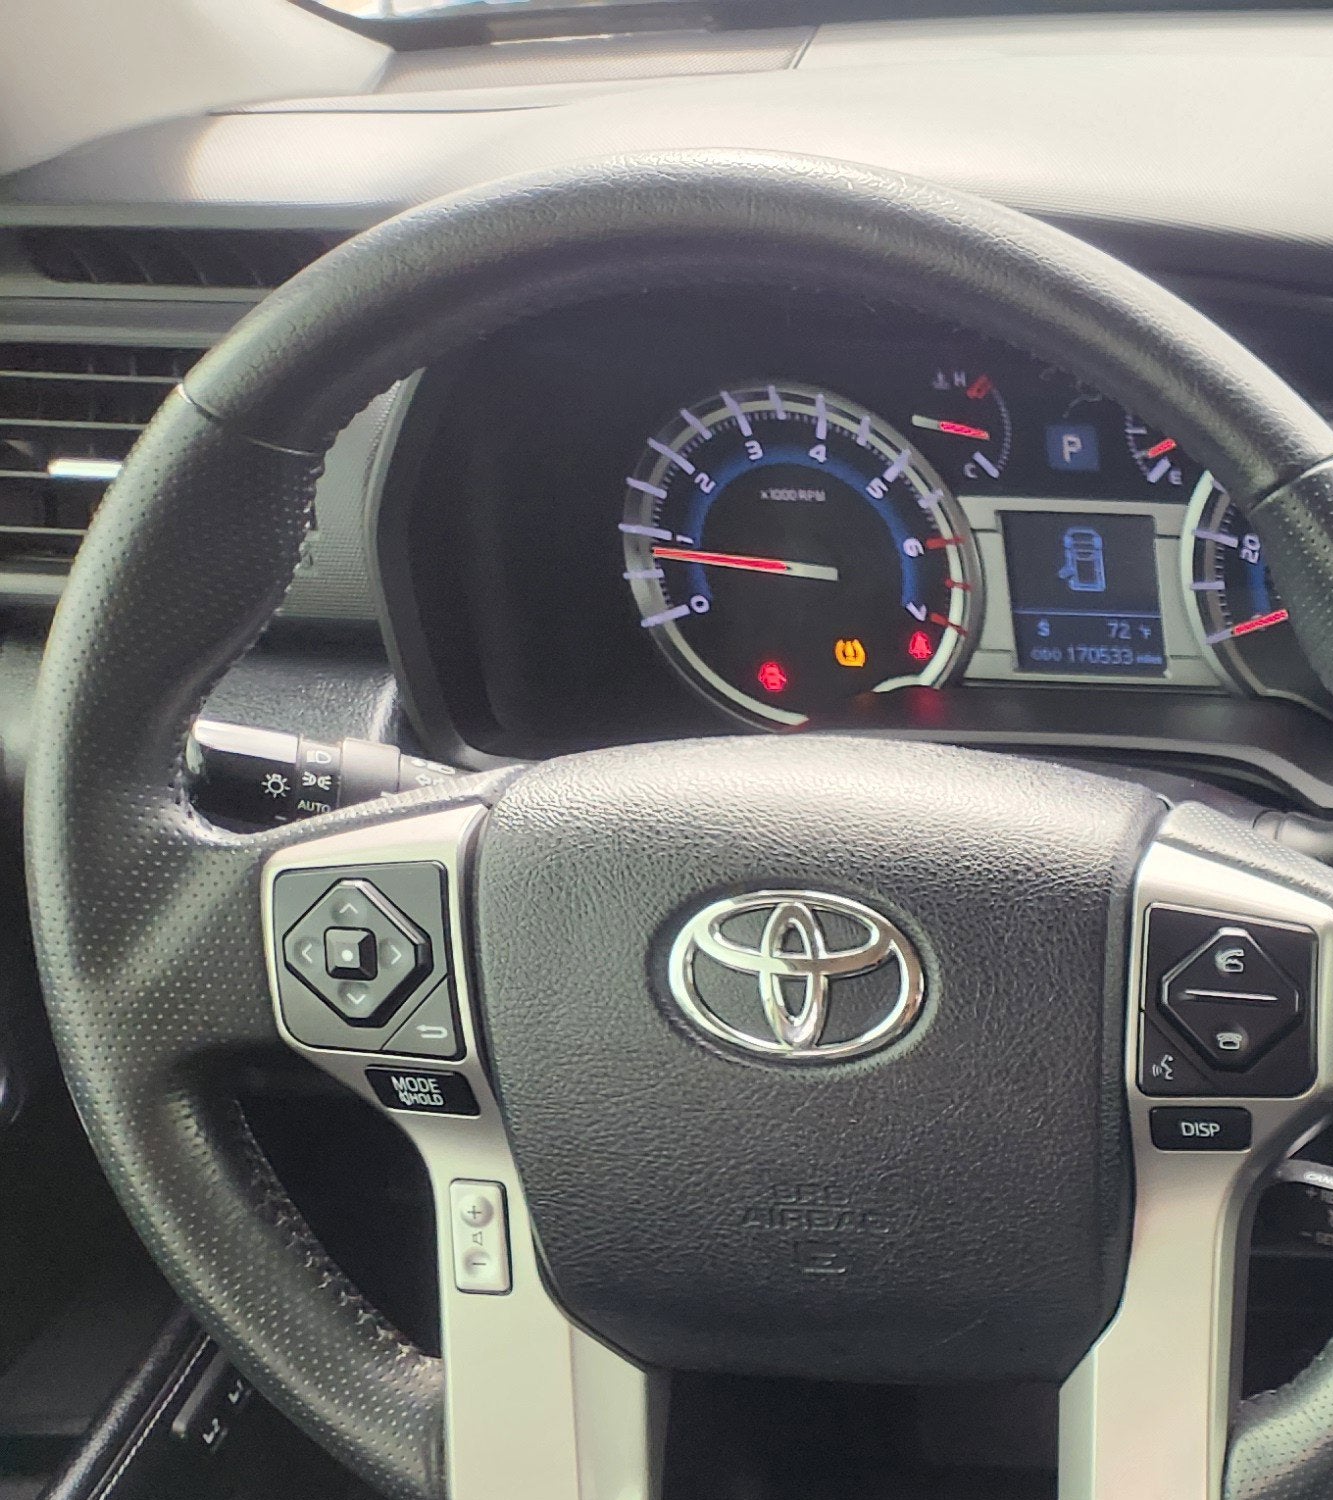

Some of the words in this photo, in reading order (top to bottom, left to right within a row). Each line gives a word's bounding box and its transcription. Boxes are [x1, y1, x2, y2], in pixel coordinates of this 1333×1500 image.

[747, 440, 764, 460] 3
[809, 444, 828, 463] 4
[1063, 434, 1082, 463] P
[694, 472, 716, 495] 2
[866, 478, 888, 499] 5
[675, 533, 694, 545] 1
[902, 537, 924, 558] 6
[1240, 533, 1261, 565] 20
[690, 595, 710, 613] 0
[905, 602, 927, 620] 7
[1107, 620, 1132, 640] 72
[297, 799, 332, 813] AUTO
[391, 1076, 441, 1093] MODE
[409, 1092, 445, 1106] HOLD
[1181, 1121, 1220, 1139] DISP
